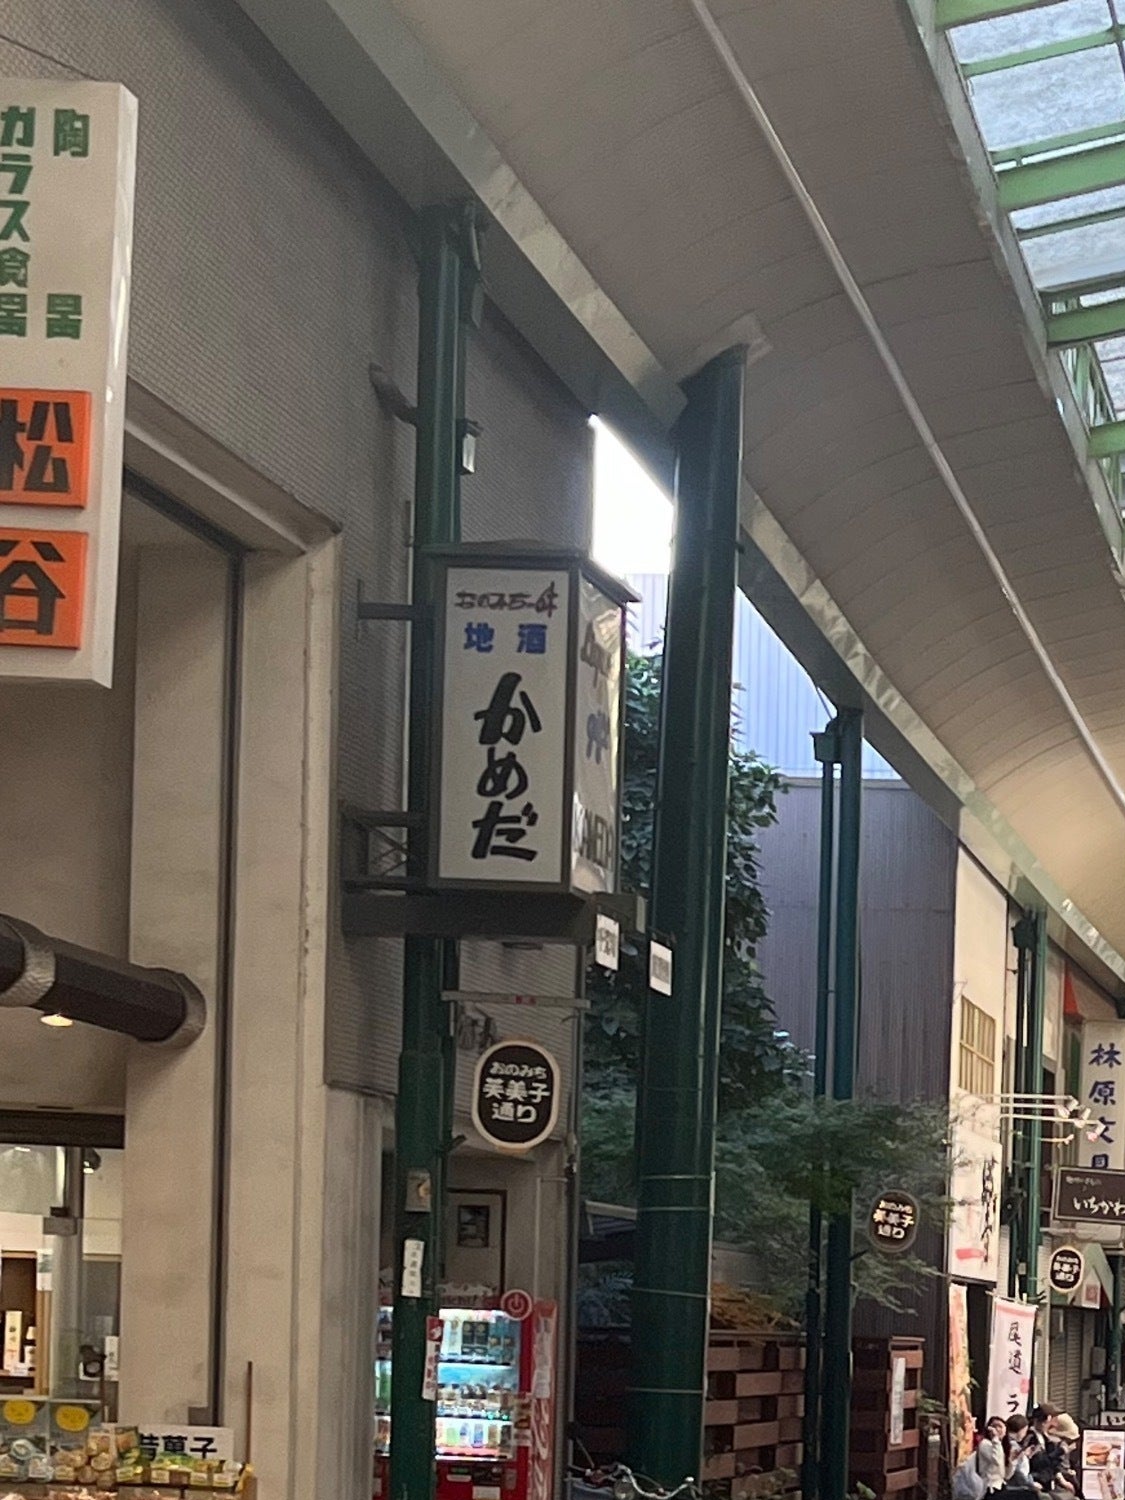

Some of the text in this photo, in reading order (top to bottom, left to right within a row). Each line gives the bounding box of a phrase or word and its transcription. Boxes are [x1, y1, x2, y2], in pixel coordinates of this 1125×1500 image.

[463, 621, 547, 654] 地酒
[472, 671, 542, 860] かめだ
[489, 1062, 548, 1079] おのみち
[482, 1077, 551, 1103] 芙美子
[491, 1103, 538, 1124] 通り
